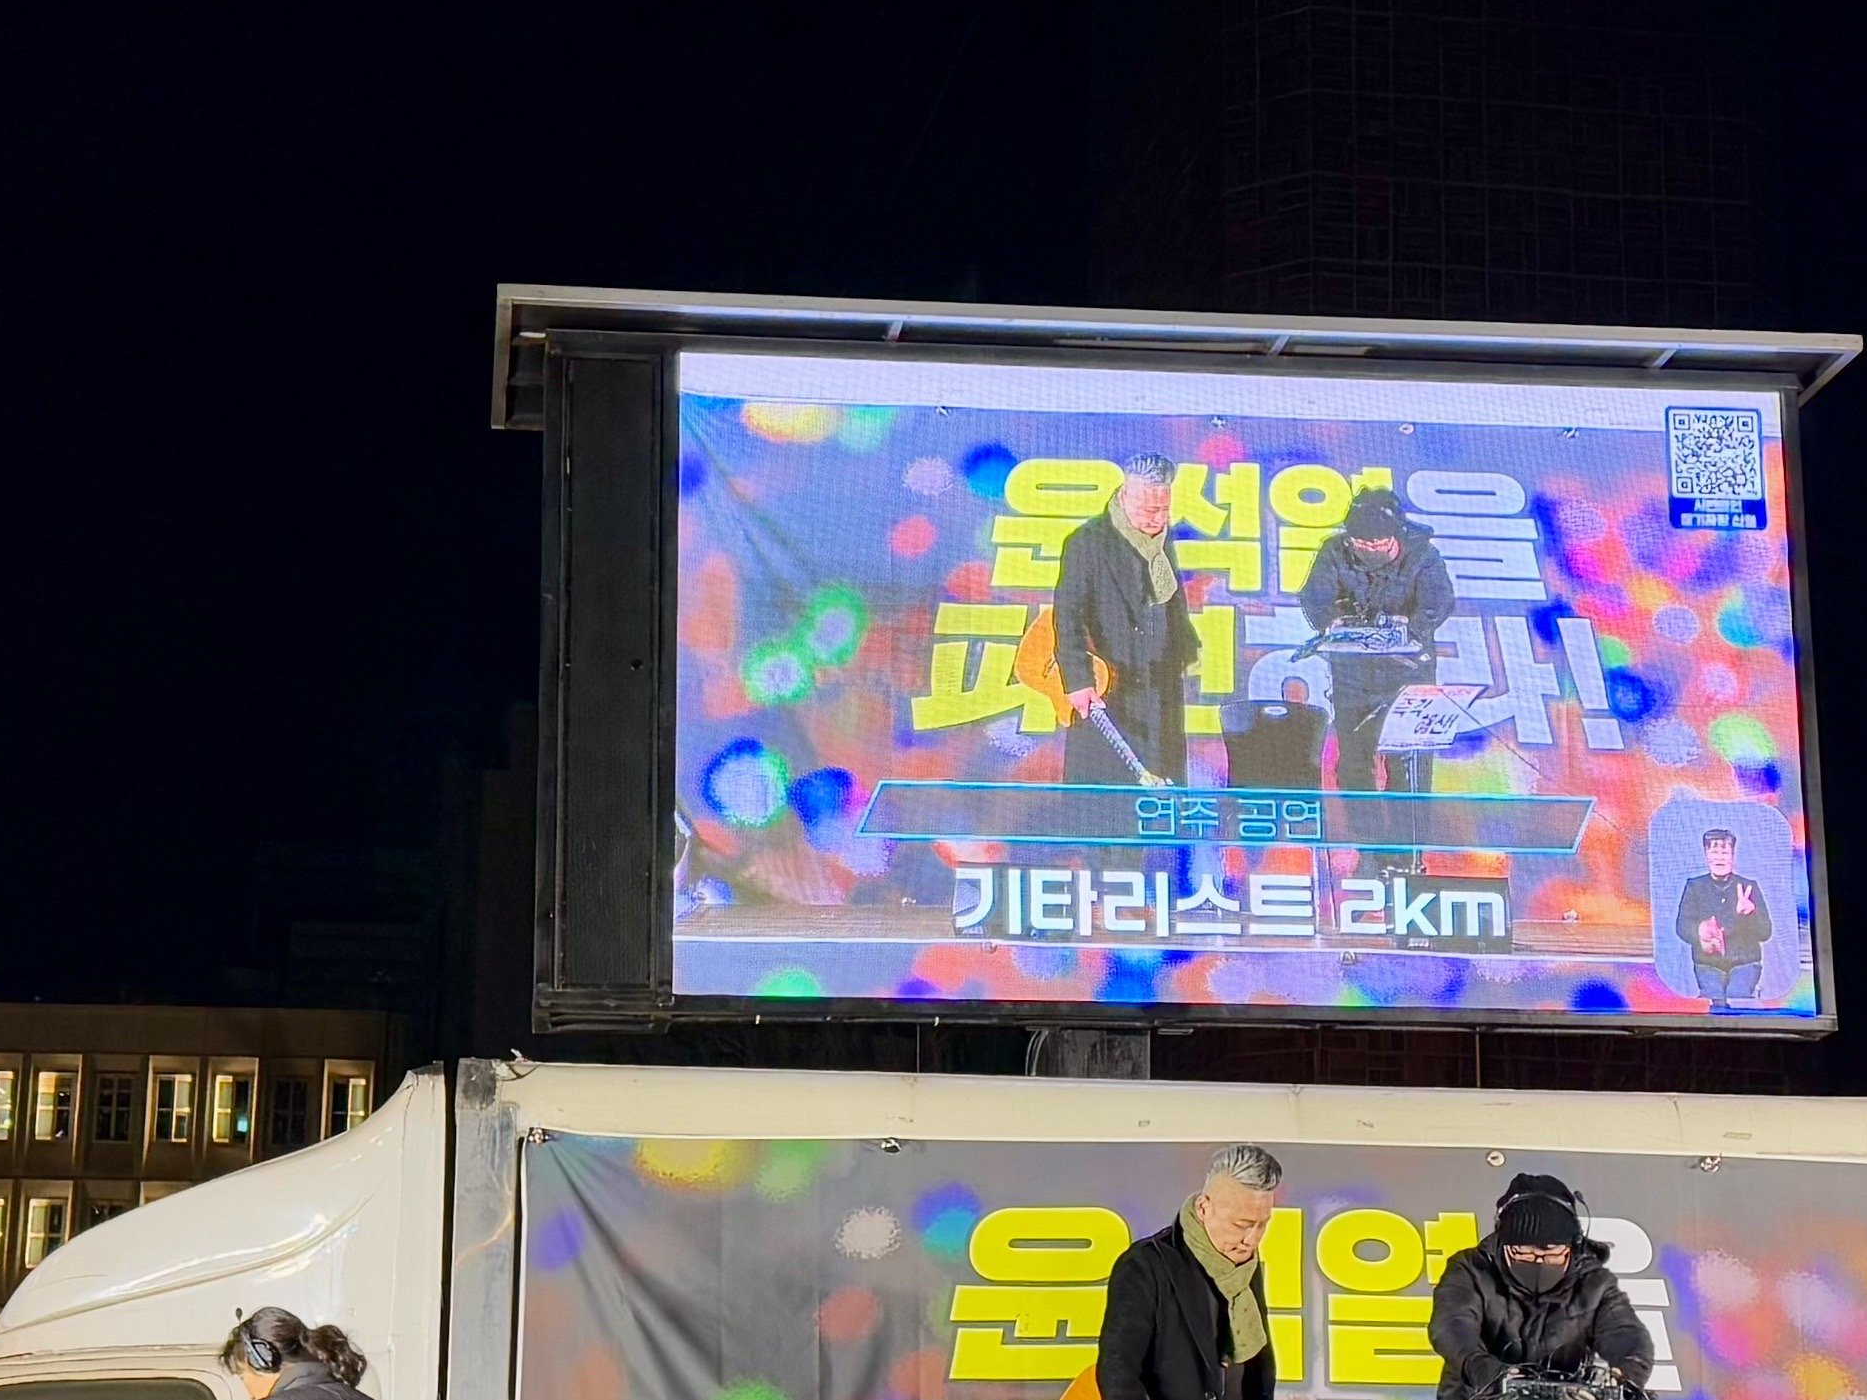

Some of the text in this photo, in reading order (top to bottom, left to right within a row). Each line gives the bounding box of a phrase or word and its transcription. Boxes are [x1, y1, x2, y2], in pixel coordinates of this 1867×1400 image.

[1135, 796, 1322, 840] 연주 공연
[952, 866, 1509, 939] 기타리스트 2km
